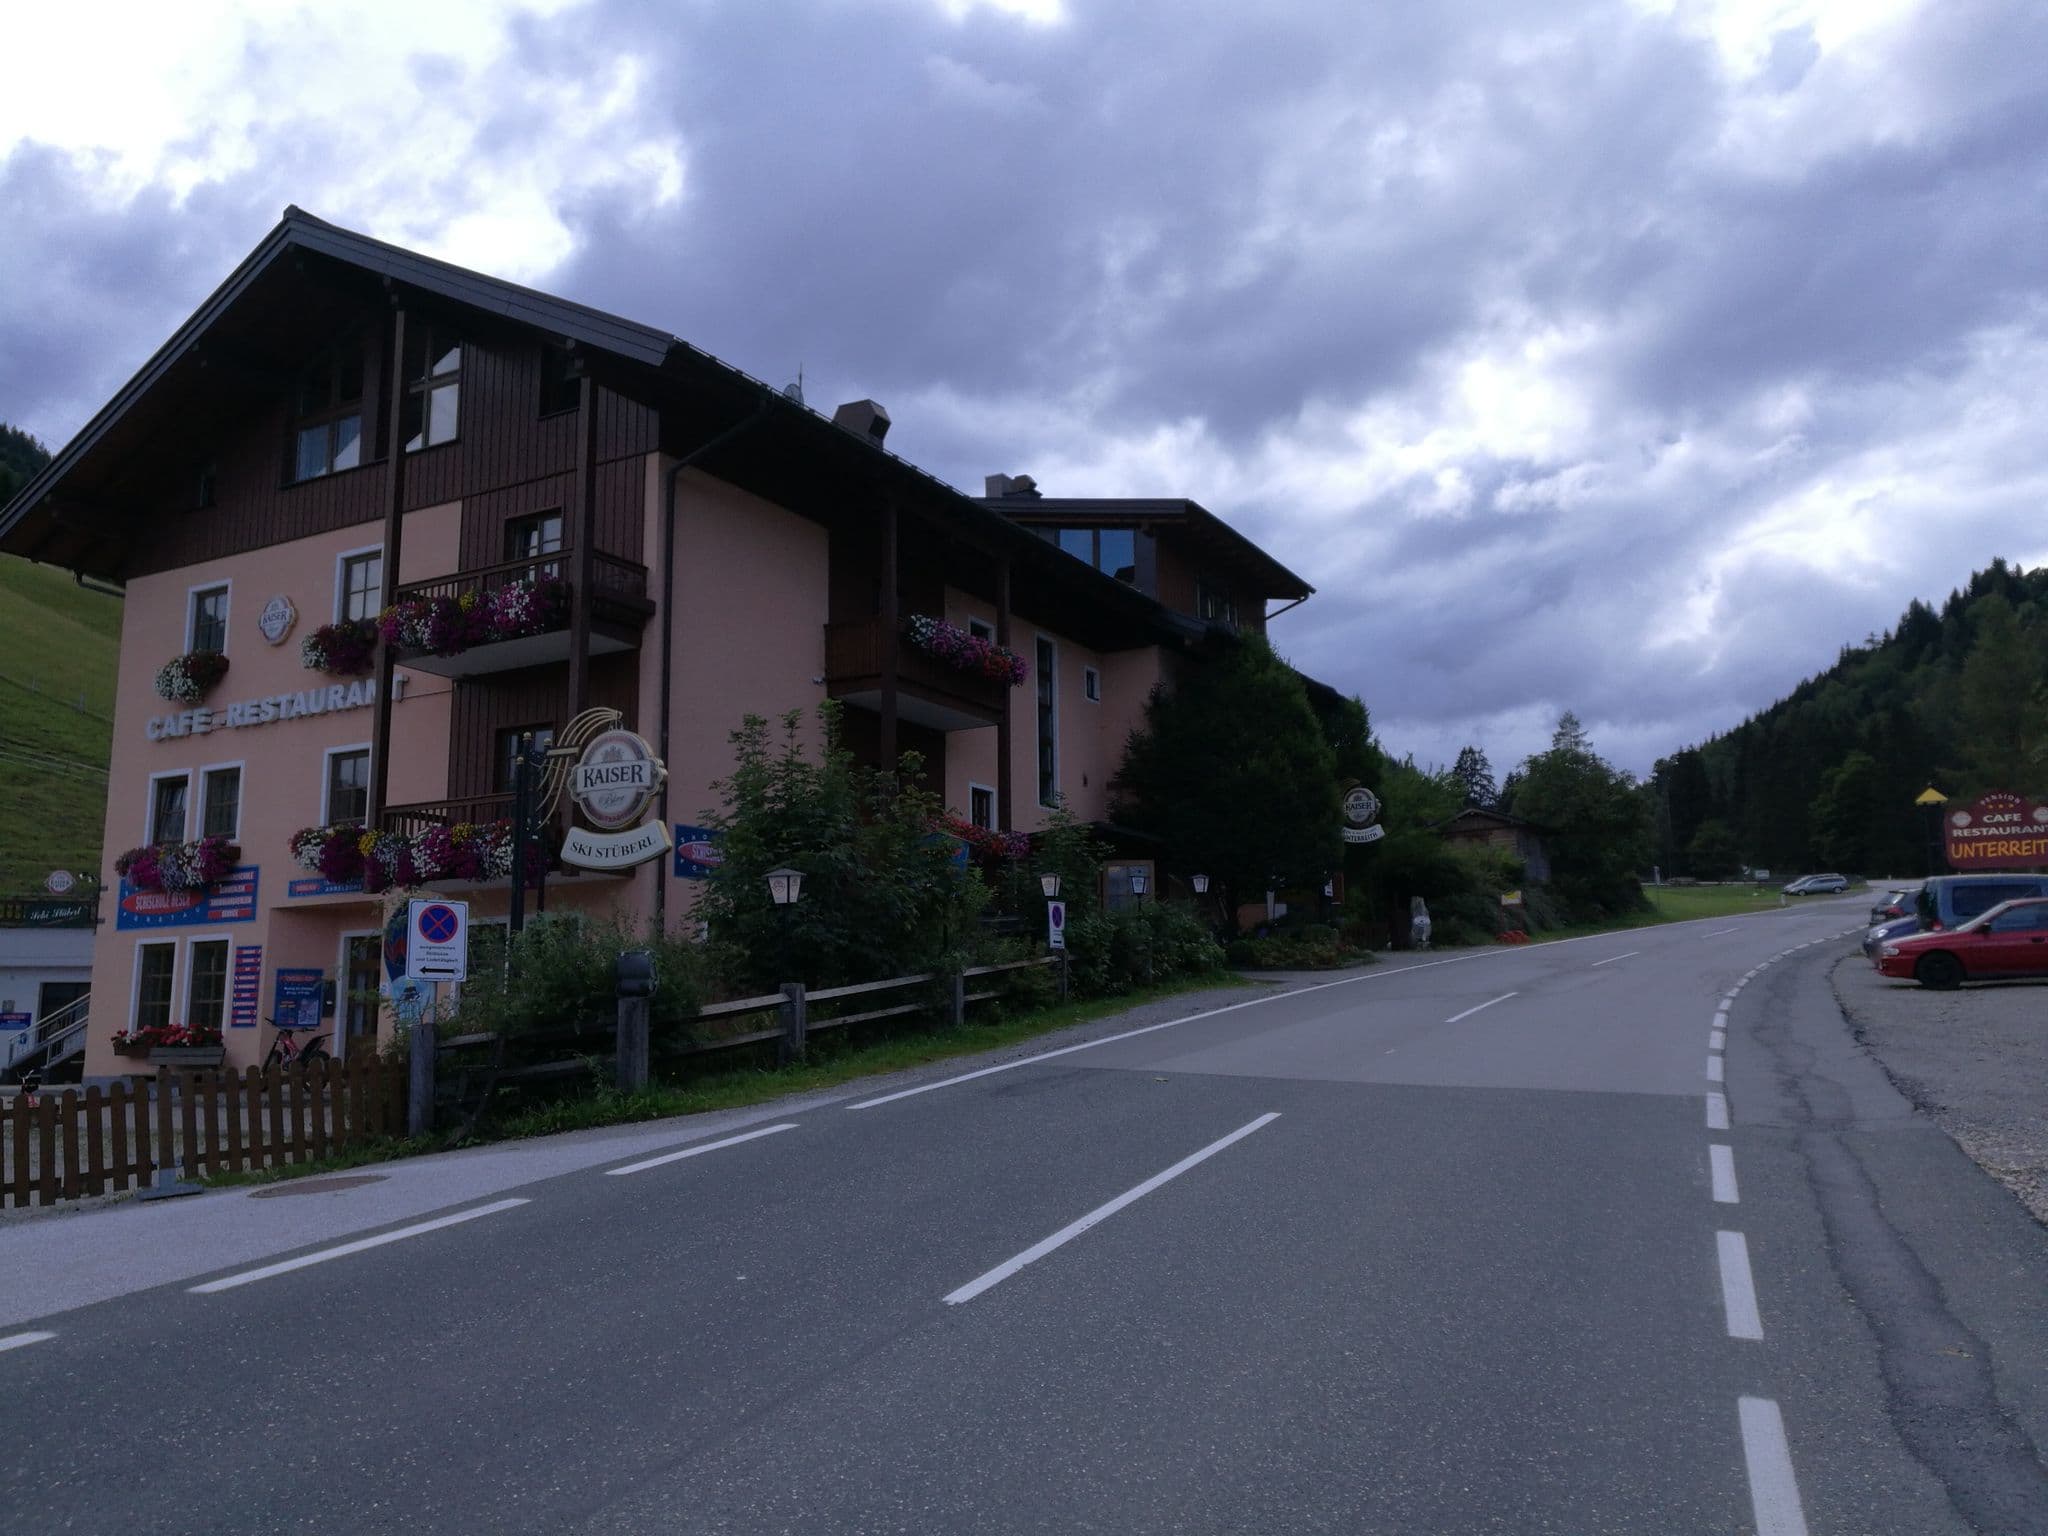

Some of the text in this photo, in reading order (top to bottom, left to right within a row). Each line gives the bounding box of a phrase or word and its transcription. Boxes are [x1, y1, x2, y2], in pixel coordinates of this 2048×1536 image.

[584, 764, 643, 788] KAISER
[1982, 813, 2022, 823] CAFE
[1952, 825, 2048, 837] RESTAURAN
[571, 839, 592, 857] SKI
[595, 836, 656, 859] STÜBERL
